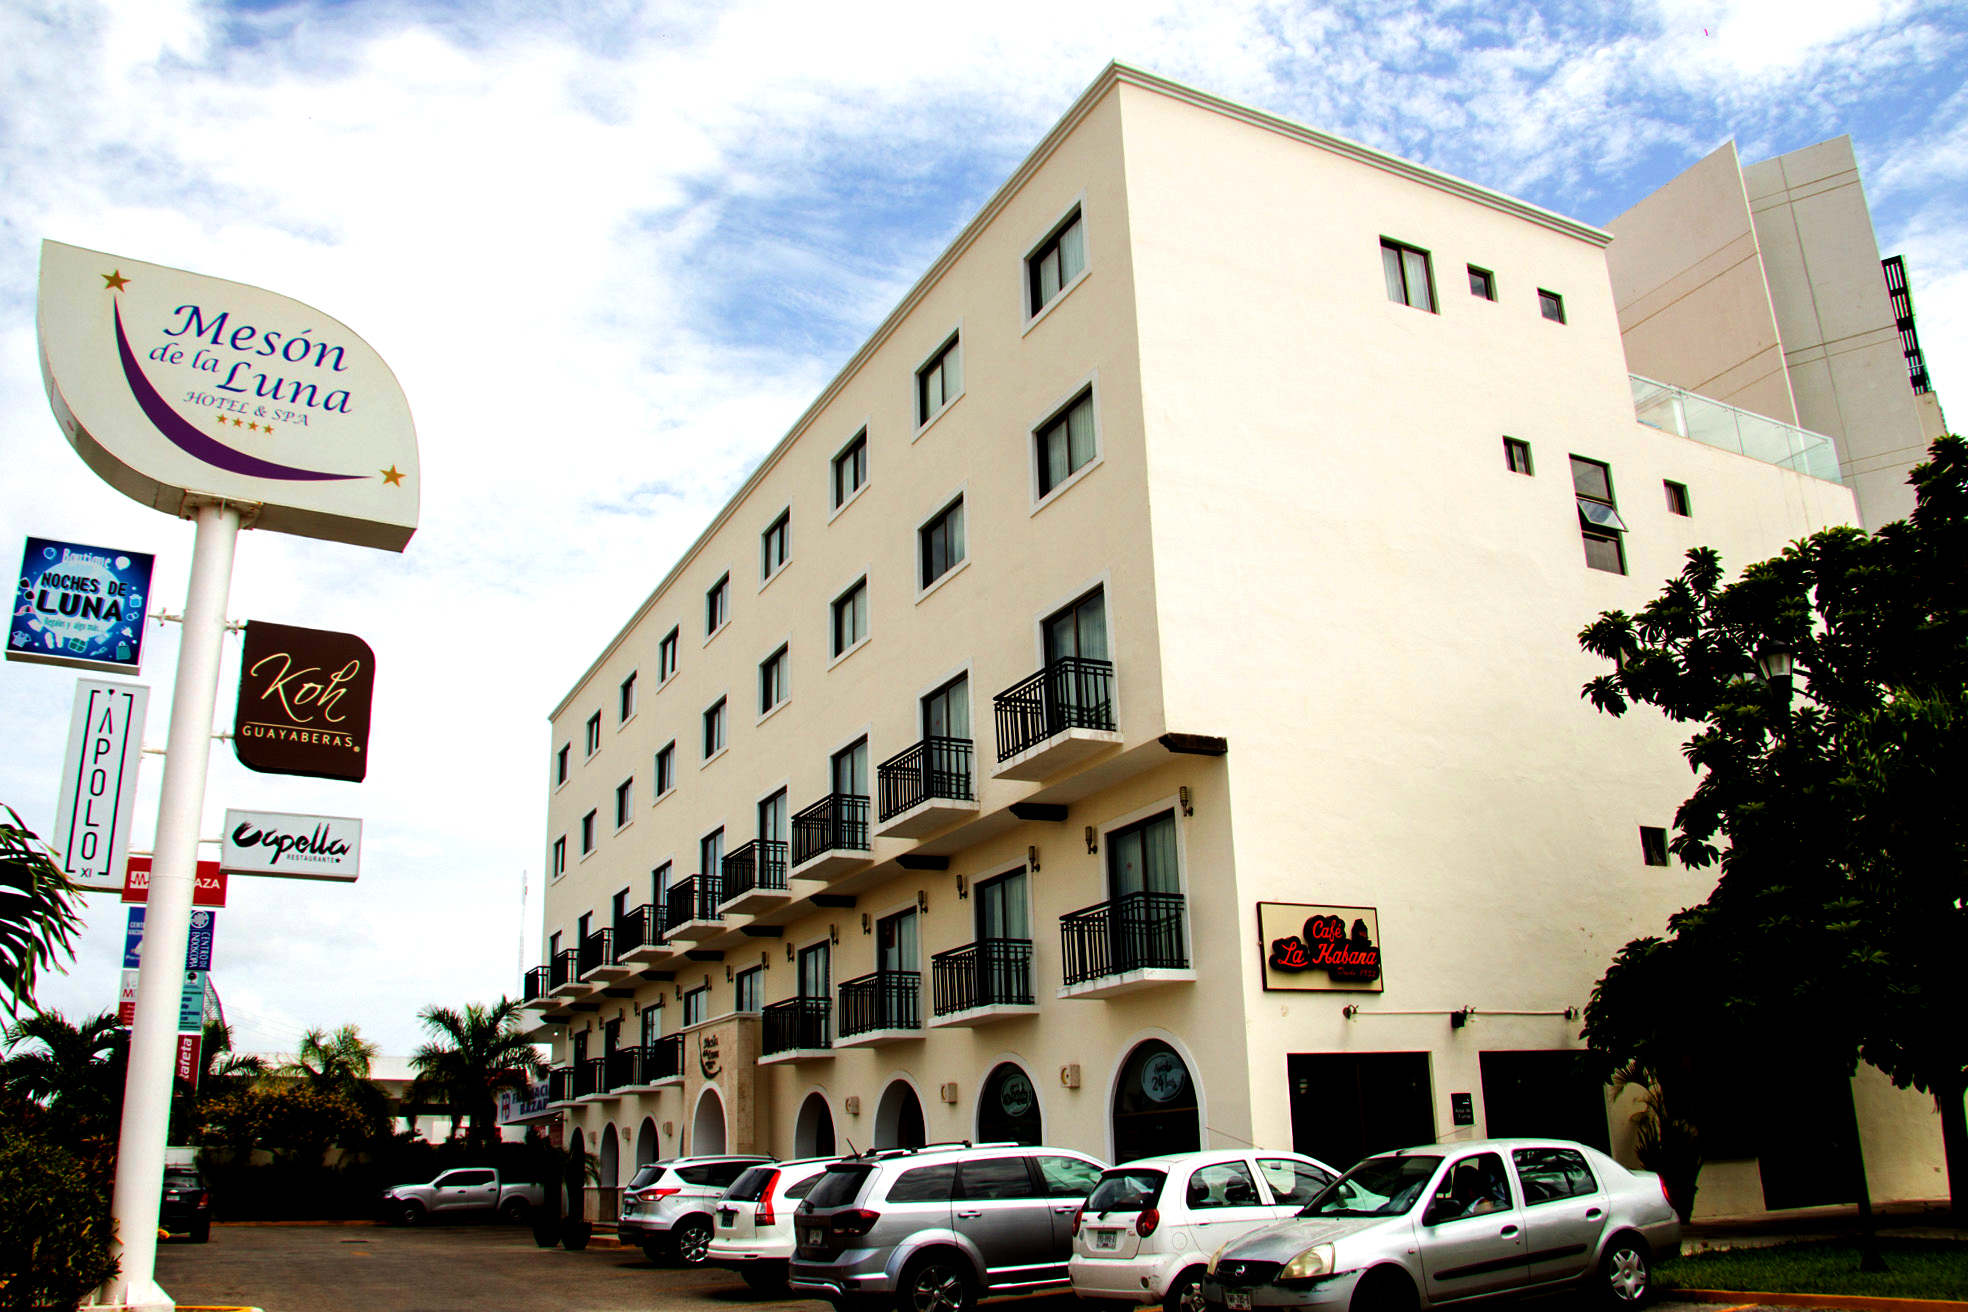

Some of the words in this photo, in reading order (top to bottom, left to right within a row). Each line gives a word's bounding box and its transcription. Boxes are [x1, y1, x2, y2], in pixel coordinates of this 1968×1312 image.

[162, 304, 349, 372] Mesón
[149, 342, 184, 365] de
[192, 349, 221, 373] la
[215, 361, 353, 414] Luna
[183, 391, 250, 414] HOTEL
[253, 405, 268, 418] &
[272, 408, 311, 427] SPA
[61, 548, 111, 569] Boutique
[41, 572, 100, 593] NOCHES
[107, 580, 128, 597] DE
[36, 588, 123, 622] LUNA
[249, 652, 360, 723] Koh
[80, 706, 113, 860] APOLO
[286, 853, 335, 864] RESTAURANTE
[80, 867, 93, 878] XI
[194, 877, 221, 889] AZA
[129, 921, 145, 929] CENT
[1312, 919, 1343, 942] Café
[198, 931, 211, 960] CENTRO
[1277, 941, 1309, 968] La
[1312, 943, 1378, 965] Habana
[1359, 969, 1377, 978] 1952
[179, 1037, 193, 1079] tafeta
[1152, 1074, 1164, 1092] 24
